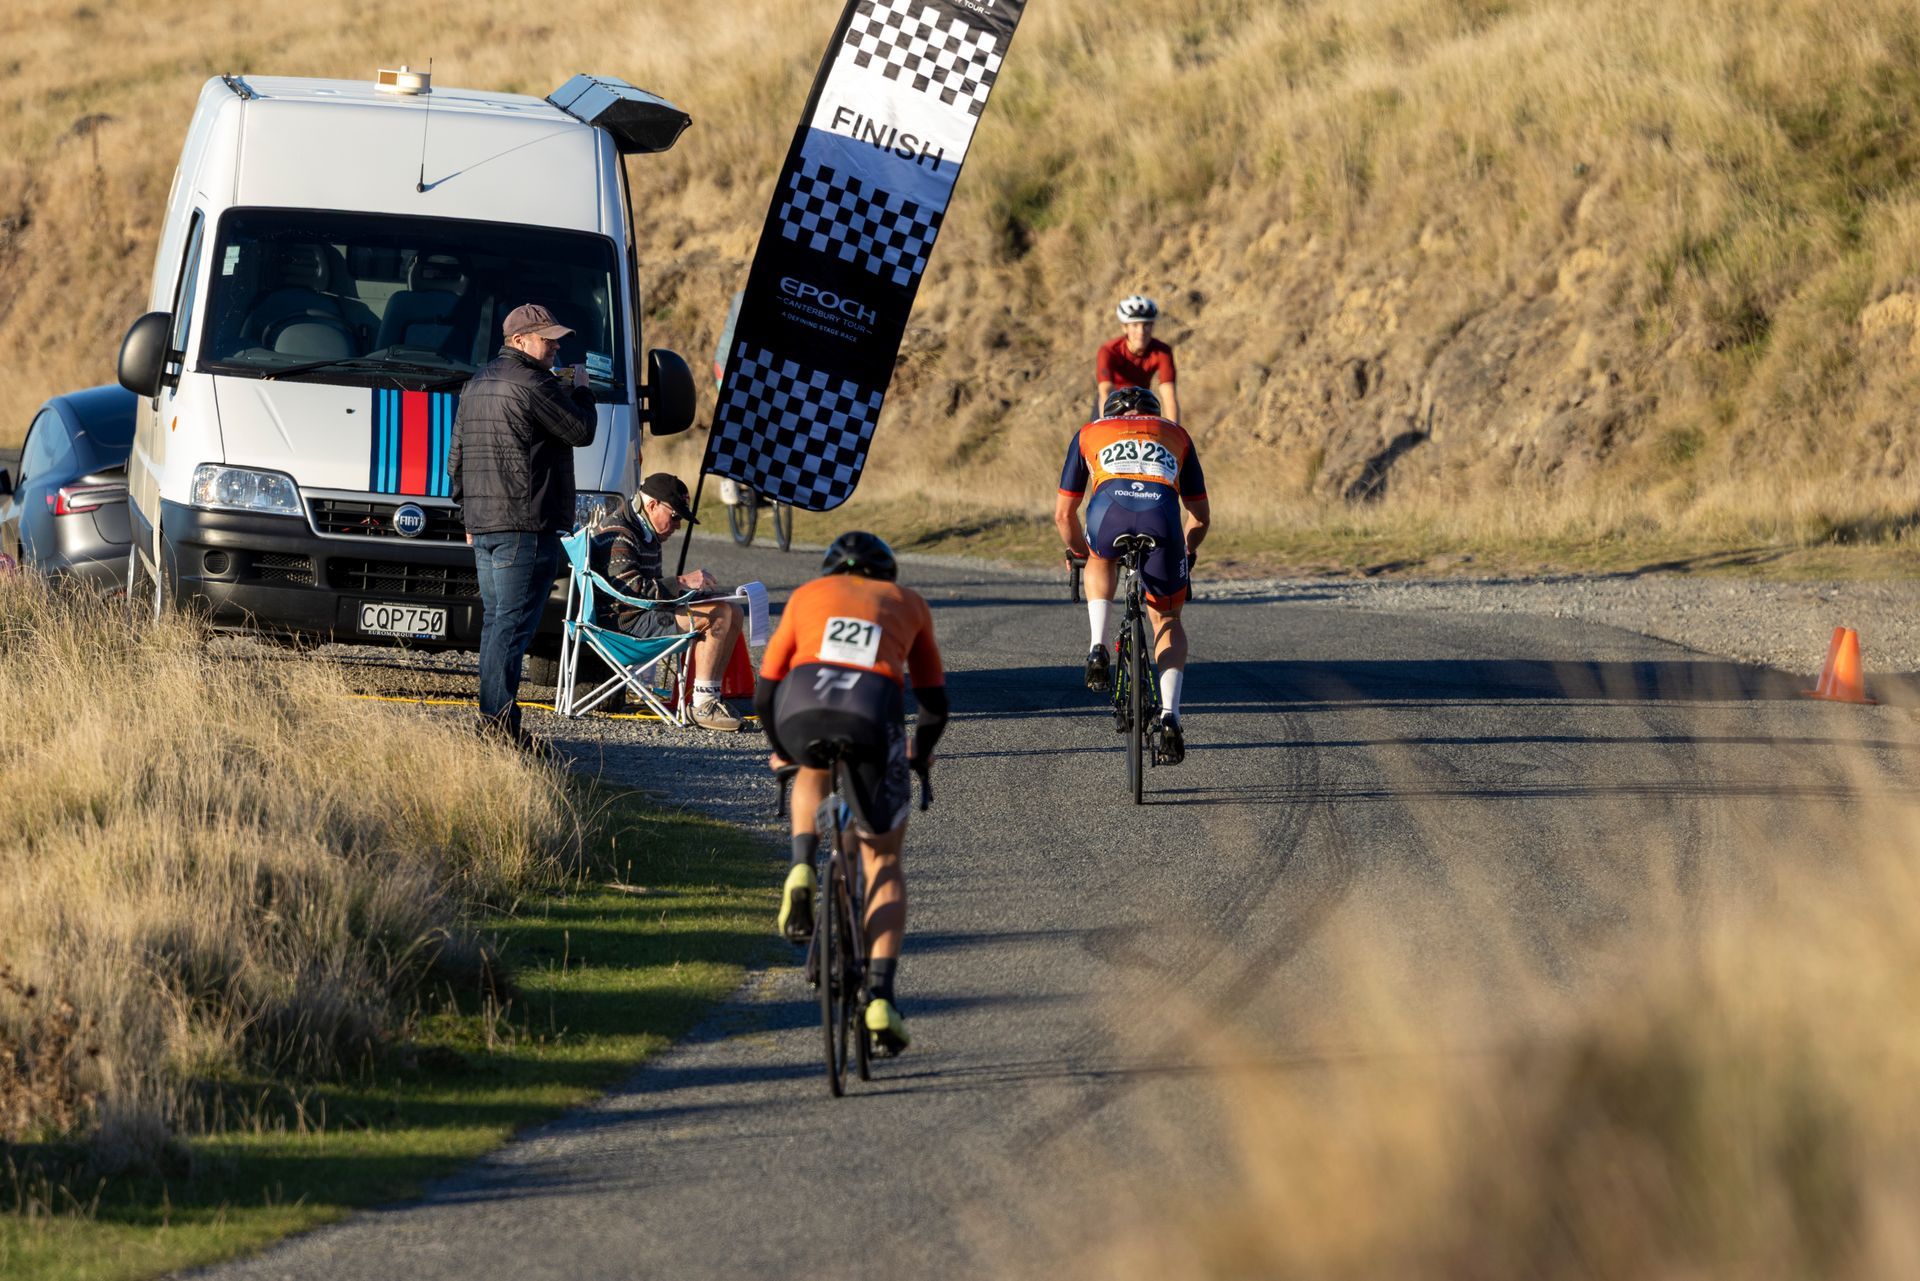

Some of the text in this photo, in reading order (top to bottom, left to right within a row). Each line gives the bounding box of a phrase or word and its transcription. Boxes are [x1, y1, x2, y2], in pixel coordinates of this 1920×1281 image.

[964, 0, 985, 14] TOUR
[830, 105, 945, 171] FINISH
[780, 277, 877, 325] EPOCH
[783, 297, 866, 333] CANTERBURY TOUR
[787, 313, 818, 329] DEFINING
[819, 325, 839, 336] STAGE
[840, 332, 857, 342] RACE
[1102, 441, 1139, 465] 223
[1142, 442, 1176, 470] 223
[1114, 490, 1162, 500] roadsafety
[400, 515, 420, 527] FIAT
[362, 607, 444, 632] CQP750
[368, 630, 414, 638] EUROMARQUE
[829, 620, 875, 647] 221
